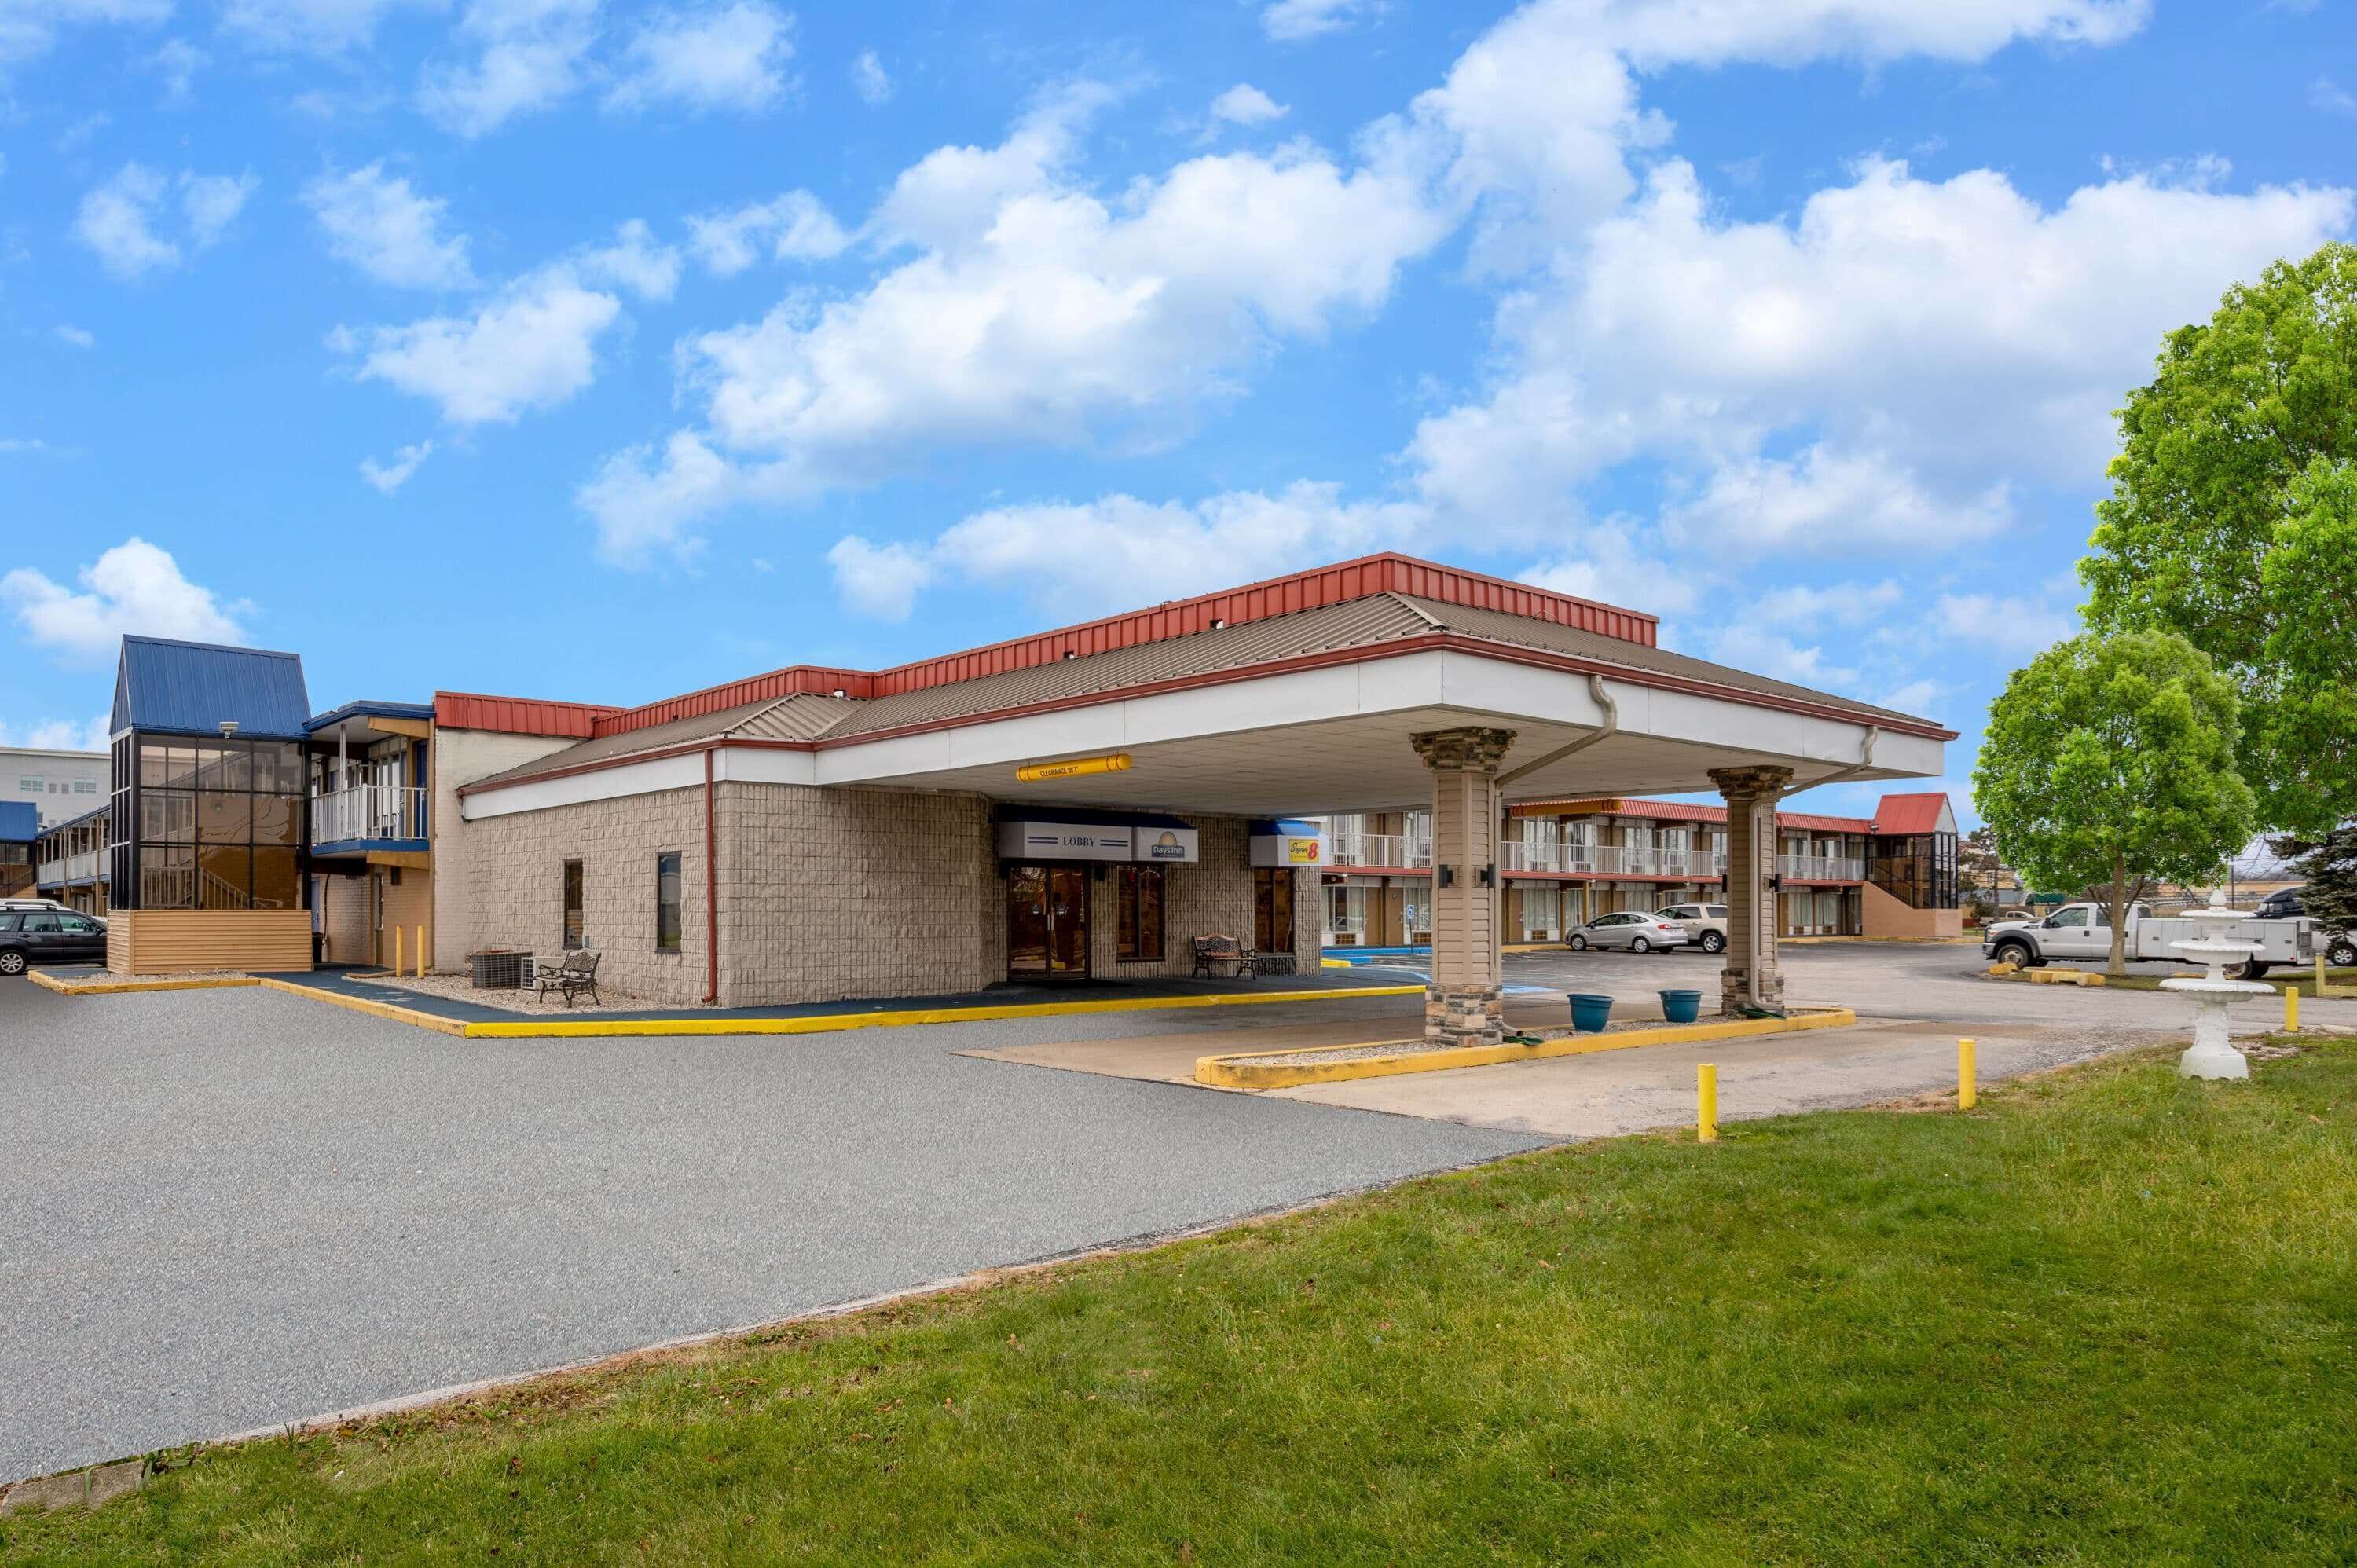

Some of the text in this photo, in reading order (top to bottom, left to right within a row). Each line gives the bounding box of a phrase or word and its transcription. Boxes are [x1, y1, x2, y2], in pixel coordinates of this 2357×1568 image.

[1039, 768, 1068, 776] CLEARANCE
[1063, 837, 1094, 847] LOBBY
[1153, 846, 1171, 855] Days
[1290, 842, 1318, 859] Super 8
